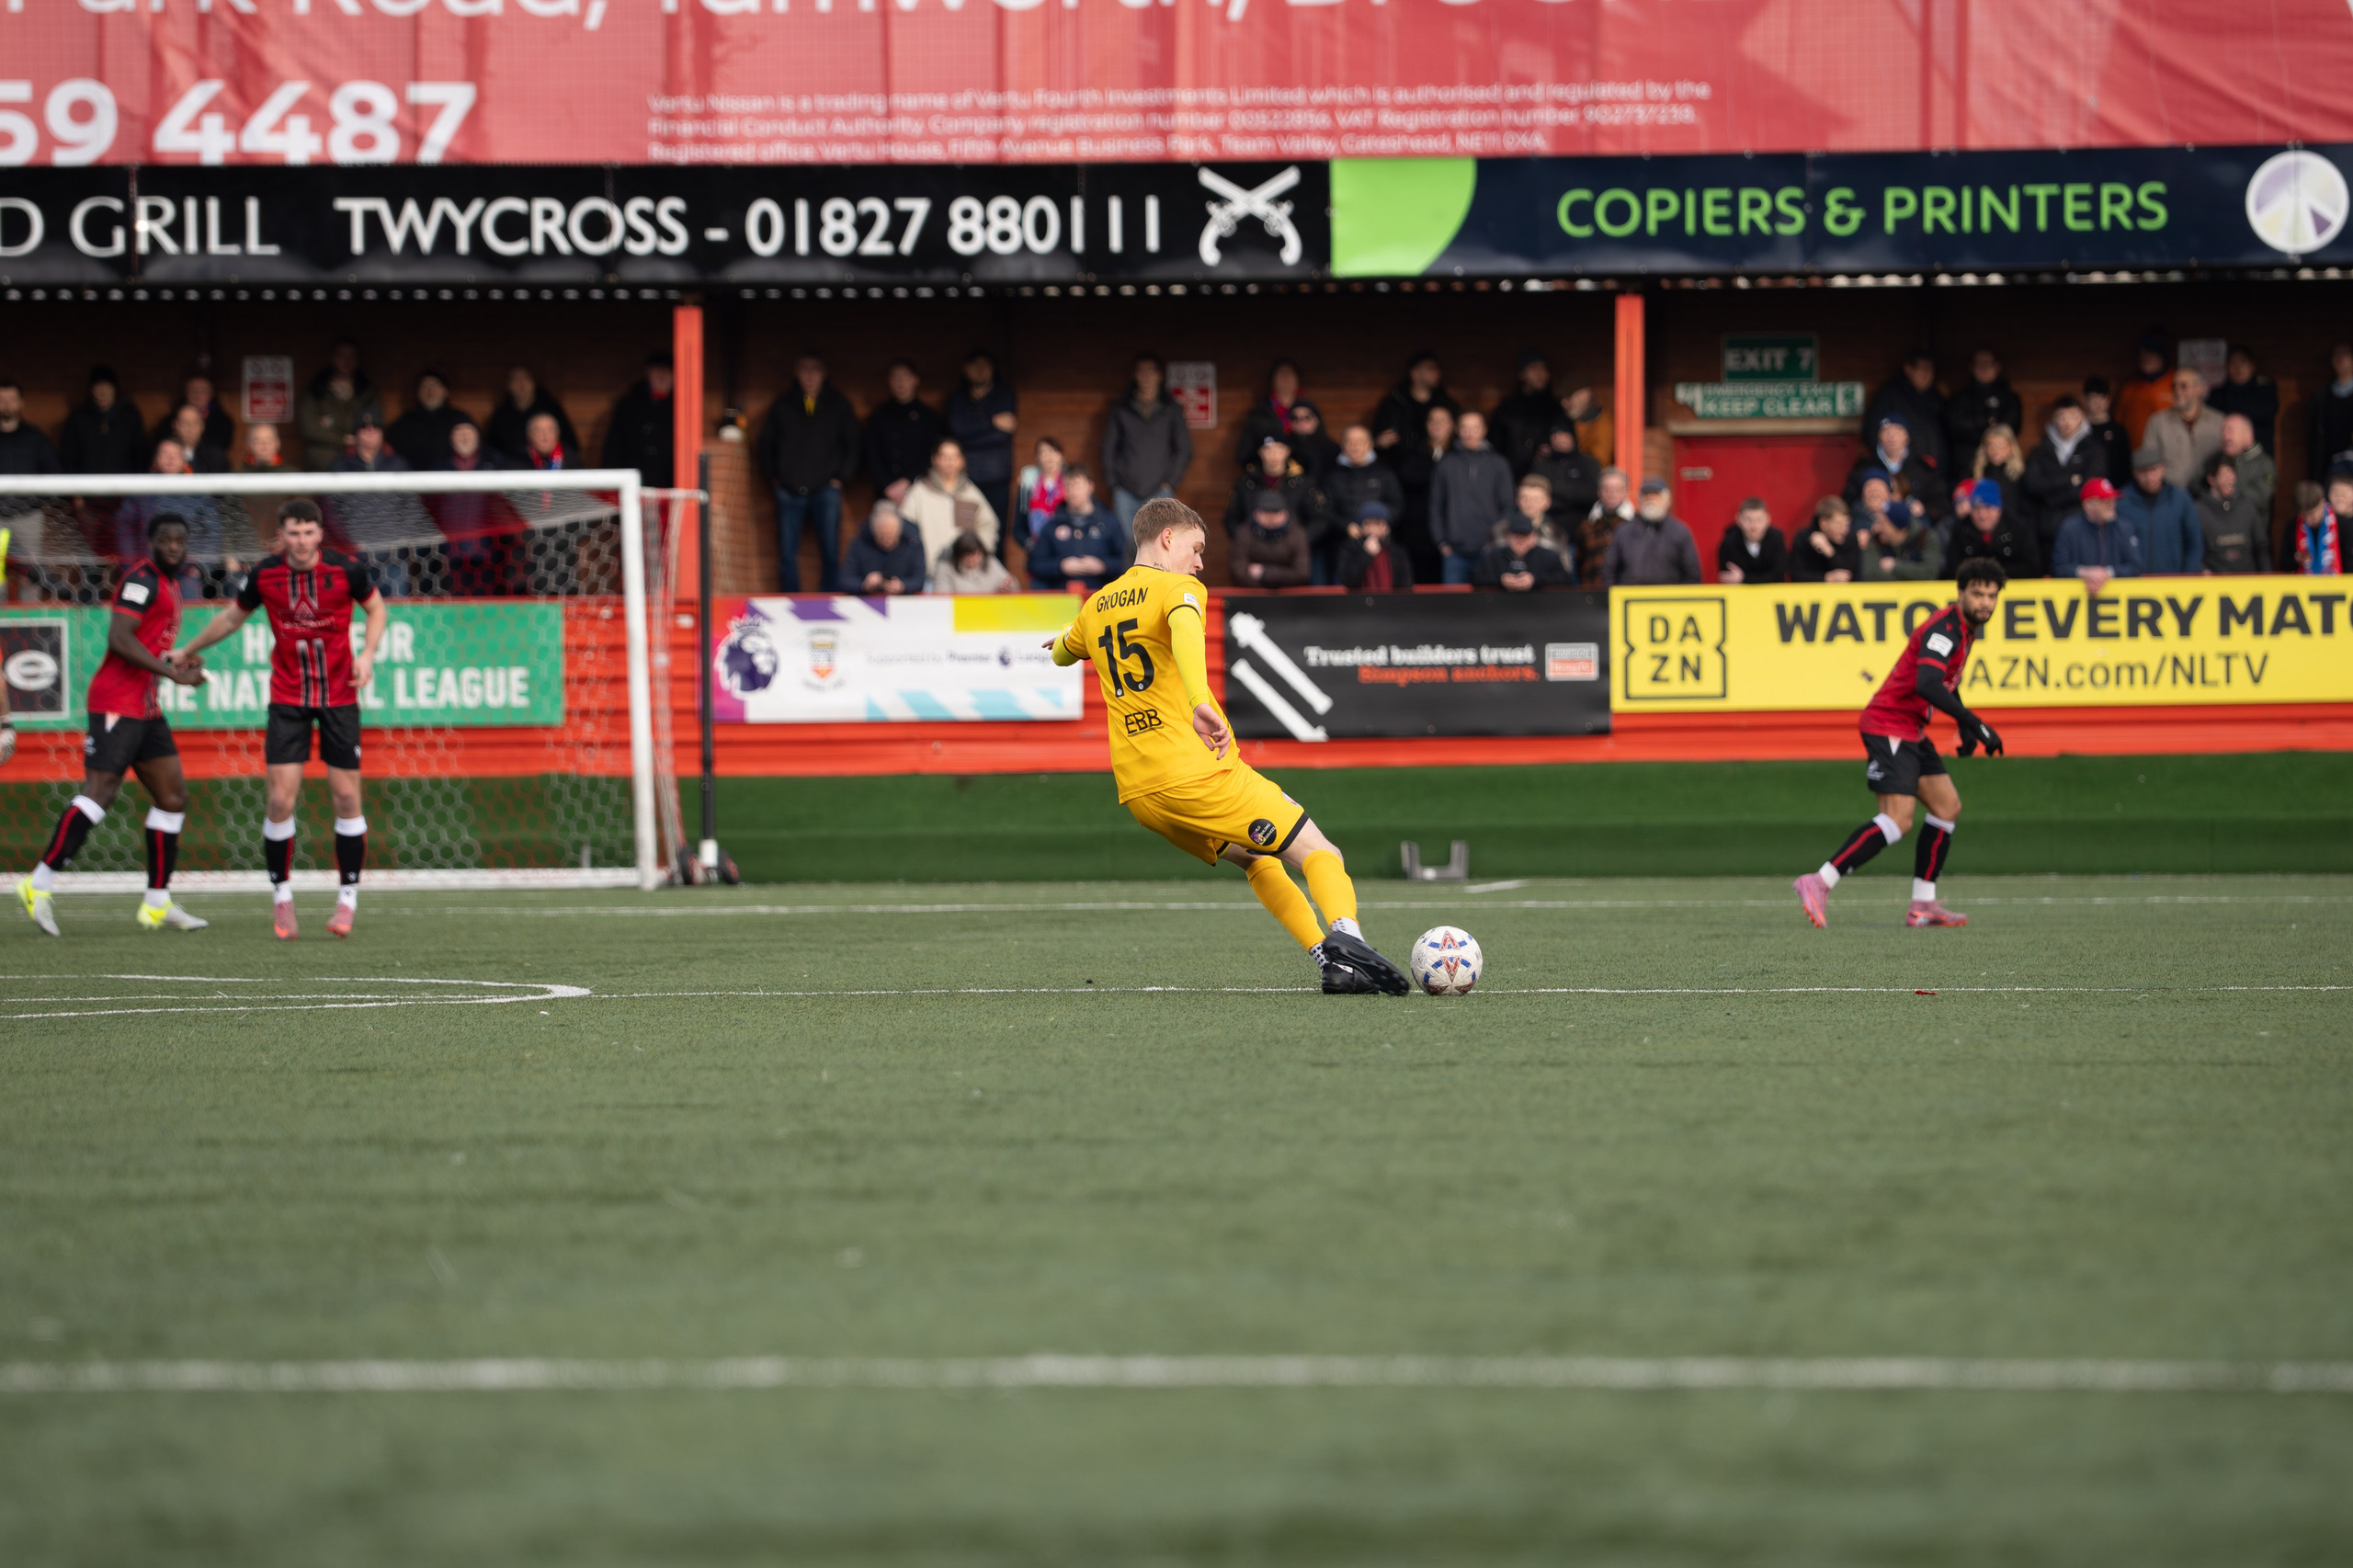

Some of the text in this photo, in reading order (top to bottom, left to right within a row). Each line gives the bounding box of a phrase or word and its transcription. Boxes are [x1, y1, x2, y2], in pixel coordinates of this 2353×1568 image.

[153, 79, 476, 165] 4487
[70, 196, 280, 257] GRILL
[334, 196, 689, 256] TWYCROSS
[745, 197, 931, 256] 01827
[947, 195, 1161, 256] 880111
[1557, 181, 2168, 238] COPIERS & PRINTERS
[1723, 347, 1813, 371] EXIT 7
[1705, 398, 1833, 415] KEEP CLEAR
[1097, 587, 1149, 613] GROGAN
[2004, 595, 2205, 641] EVERY
[2218, 593, 2353, 637] MAT
[1098, 618, 1154, 698] 15
[1304, 644, 1535, 666] Trusted builders trust
[1958, 653, 2269, 693] AZN.com/NLTV
[393, 665, 530, 710] LEAGUE
[1358, 665, 1449, 687] Simpson
[1124, 709, 1163, 735] EBB
